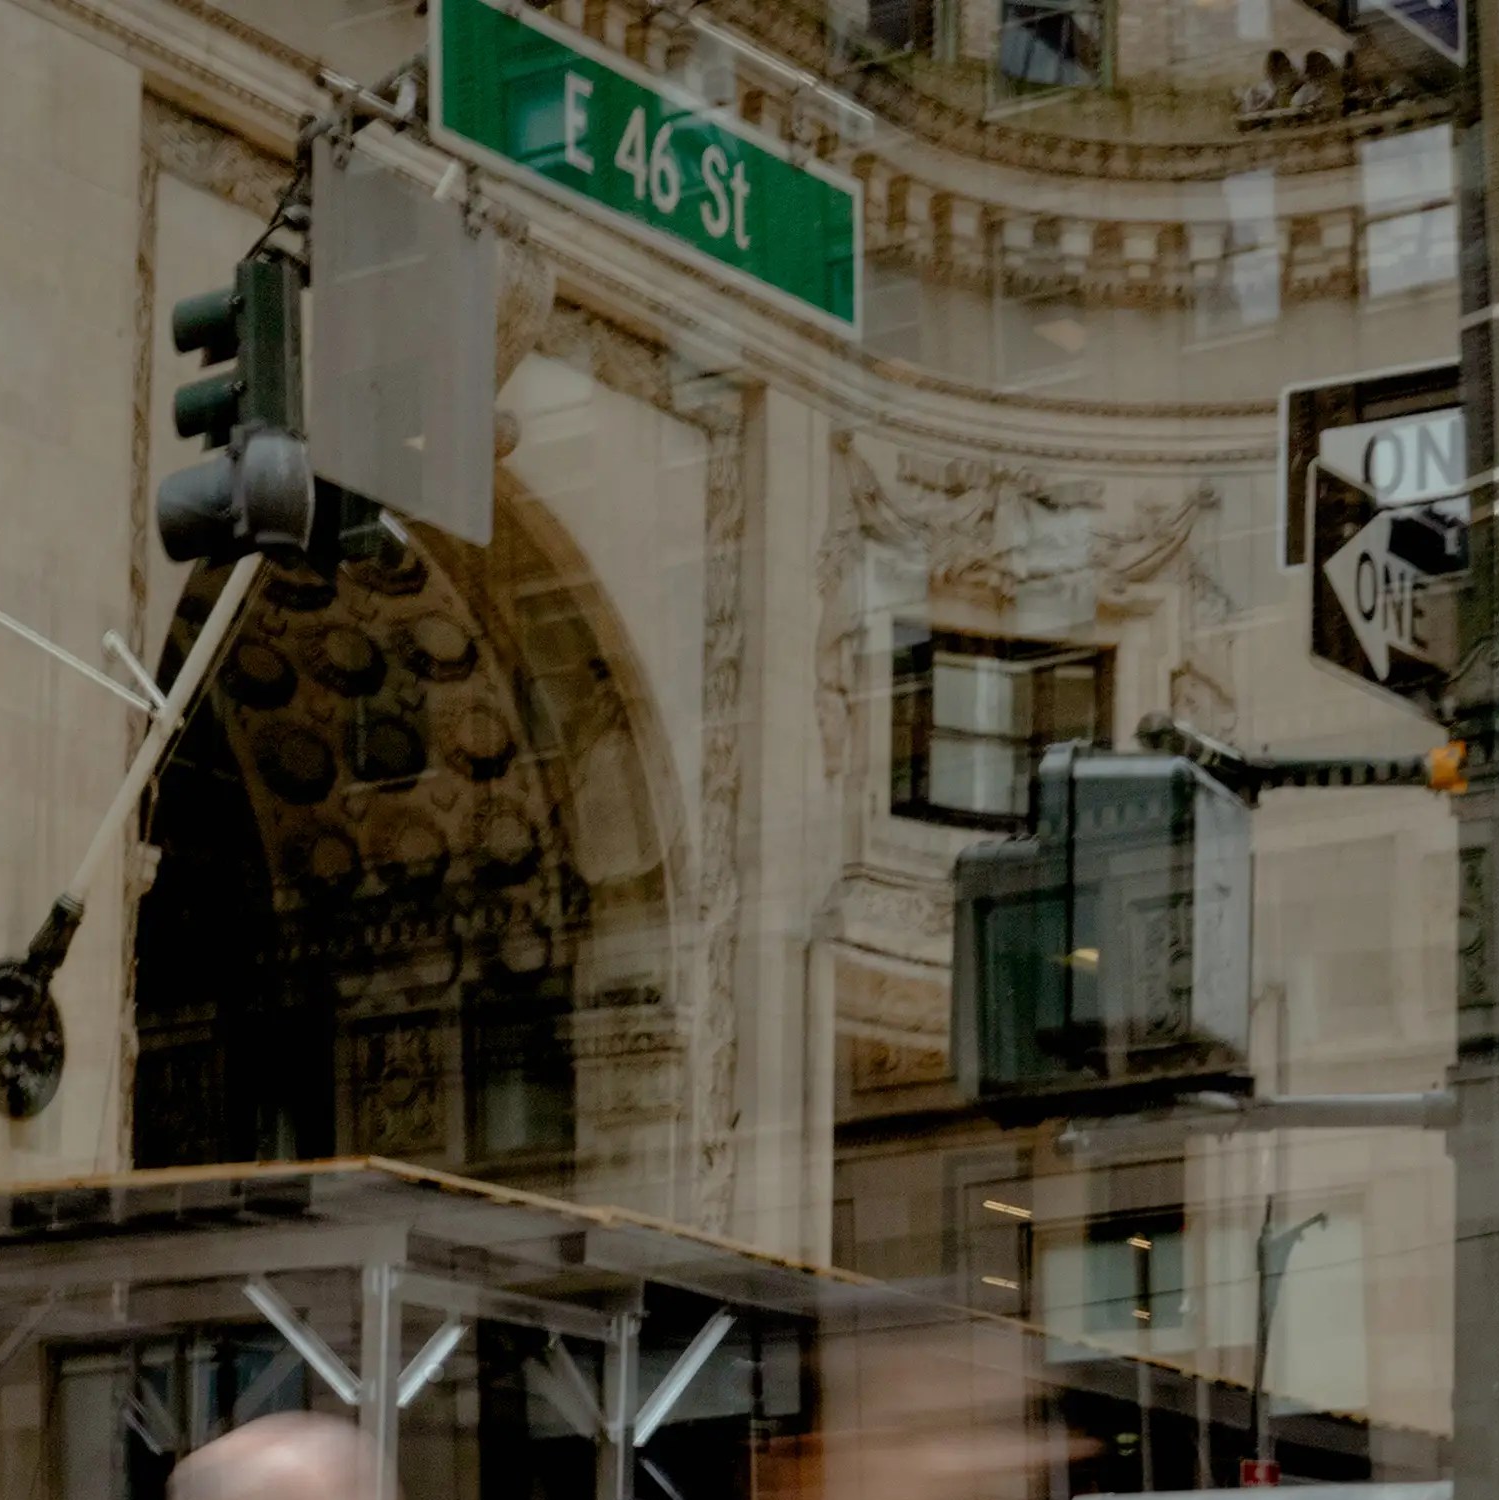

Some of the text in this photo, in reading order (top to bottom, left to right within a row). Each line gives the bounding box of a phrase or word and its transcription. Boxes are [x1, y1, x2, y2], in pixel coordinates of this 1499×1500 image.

[564, 69, 751, 250] E 46 St
[1363, 416, 1466, 497] ON
